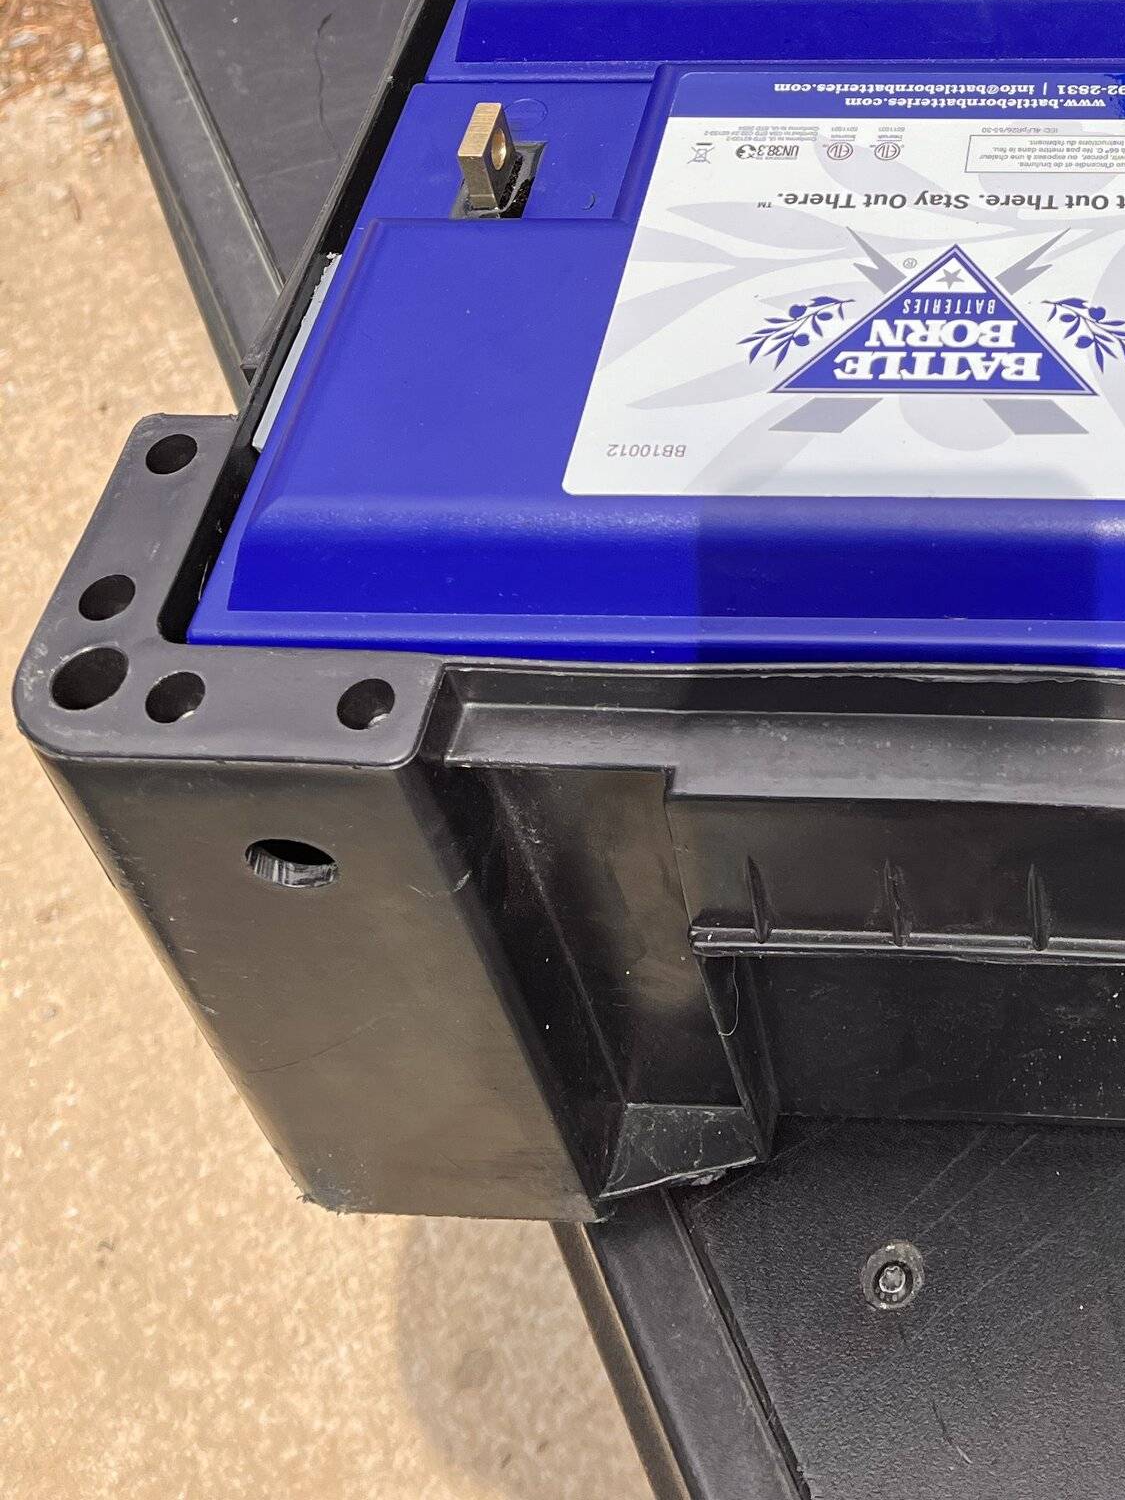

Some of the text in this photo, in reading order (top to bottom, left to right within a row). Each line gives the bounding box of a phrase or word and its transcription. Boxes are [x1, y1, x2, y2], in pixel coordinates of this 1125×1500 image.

[774, 82, 1035, 95] info@battlebornbatteries.com
[845, 97, 1106, 109] www.battlebornbatteries.com
[757, 145, 799, 156] UN38.3
[863, 193, 907, 208] Out
[915, 190, 970, 210] Stay
[978, 194, 1058, 210] There.
[1065, 194, 1109, 210] Out
[902, 298, 996, 315] BATTERIES
[865, 319, 1018, 348] BORN
[832, 351, 1043, 382] BATTLE
[607, 444, 686, 457] BB10012
